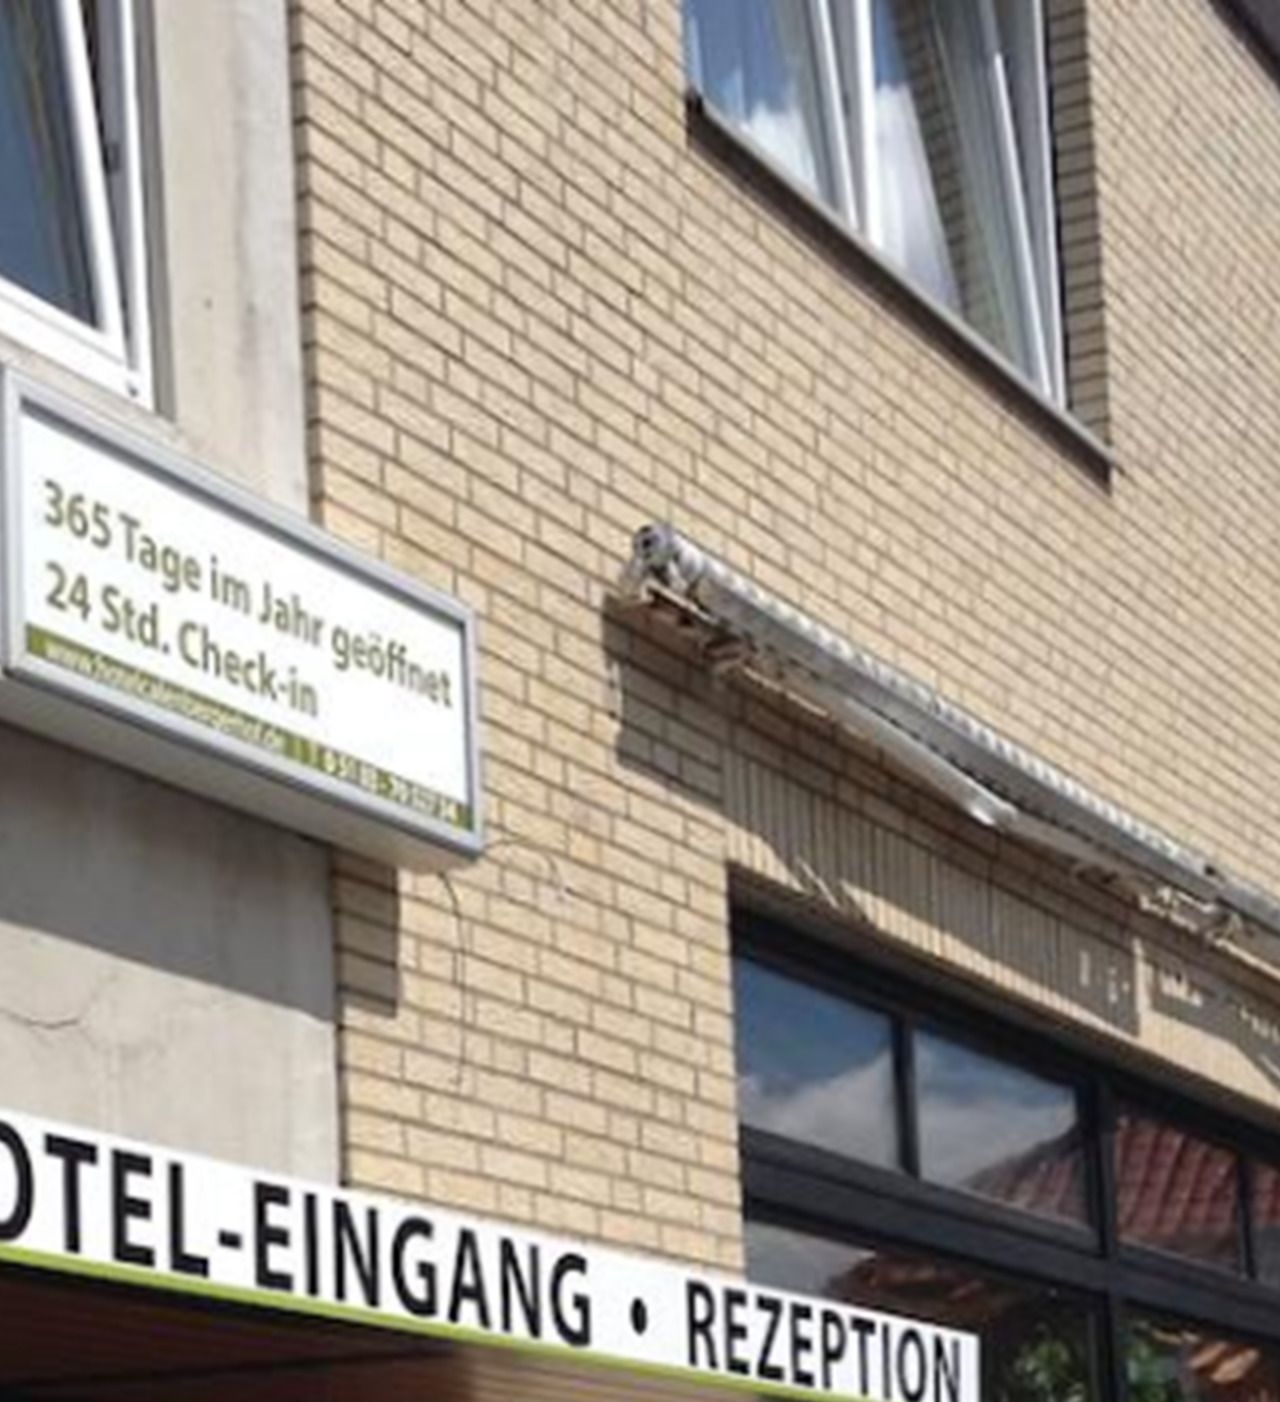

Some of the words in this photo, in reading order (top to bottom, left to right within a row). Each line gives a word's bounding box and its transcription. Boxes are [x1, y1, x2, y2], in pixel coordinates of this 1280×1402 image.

[42, 479, 112, 550] 365
[118, 512, 202, 594] Tage
[209, 555, 252, 615] im
[259, 584, 322, 648] Jahr
[330, 623, 452, 709] geöffnet
[45, 562, 91, 621] 24
[101, 584, 171, 654] Std.
[178, 621, 318, 718] Check-in
